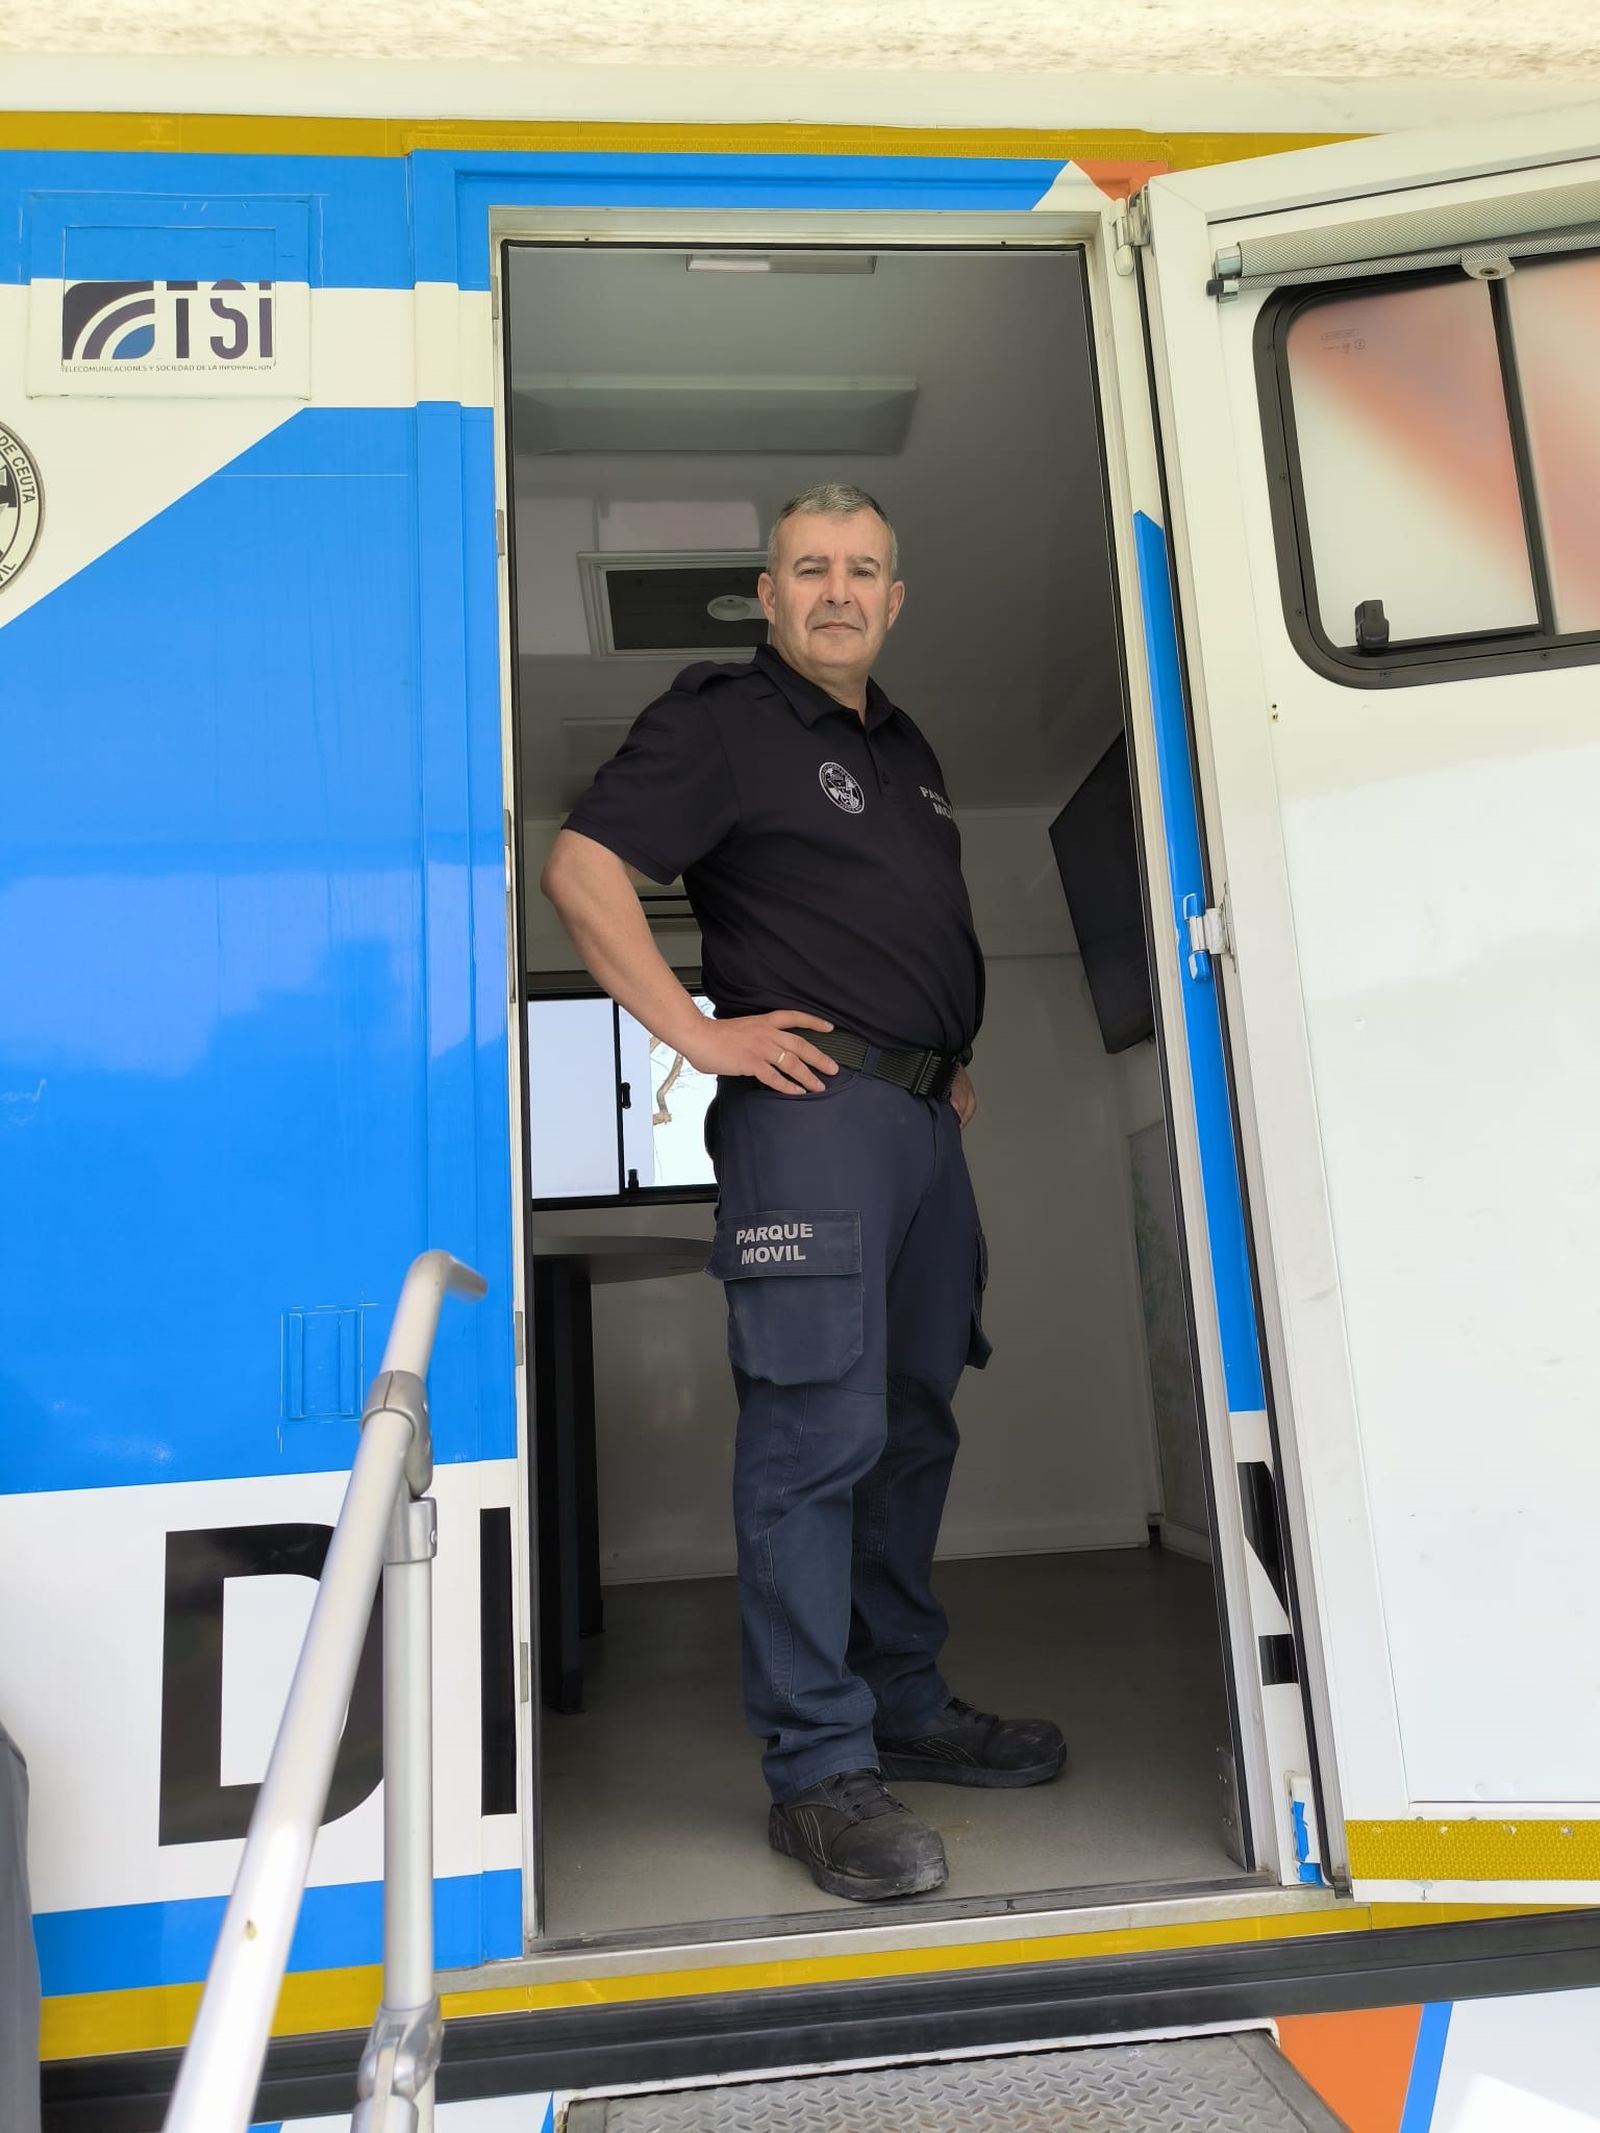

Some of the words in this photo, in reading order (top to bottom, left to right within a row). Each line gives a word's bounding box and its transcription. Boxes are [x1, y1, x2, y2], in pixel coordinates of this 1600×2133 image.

[155, 364, 194, 372] SOCIEDAD
[12, 457, 36, 504] CEUTA
[736, 1223, 814, 1246] PARQUE
[741, 1245, 807, 1265] MOVIL
